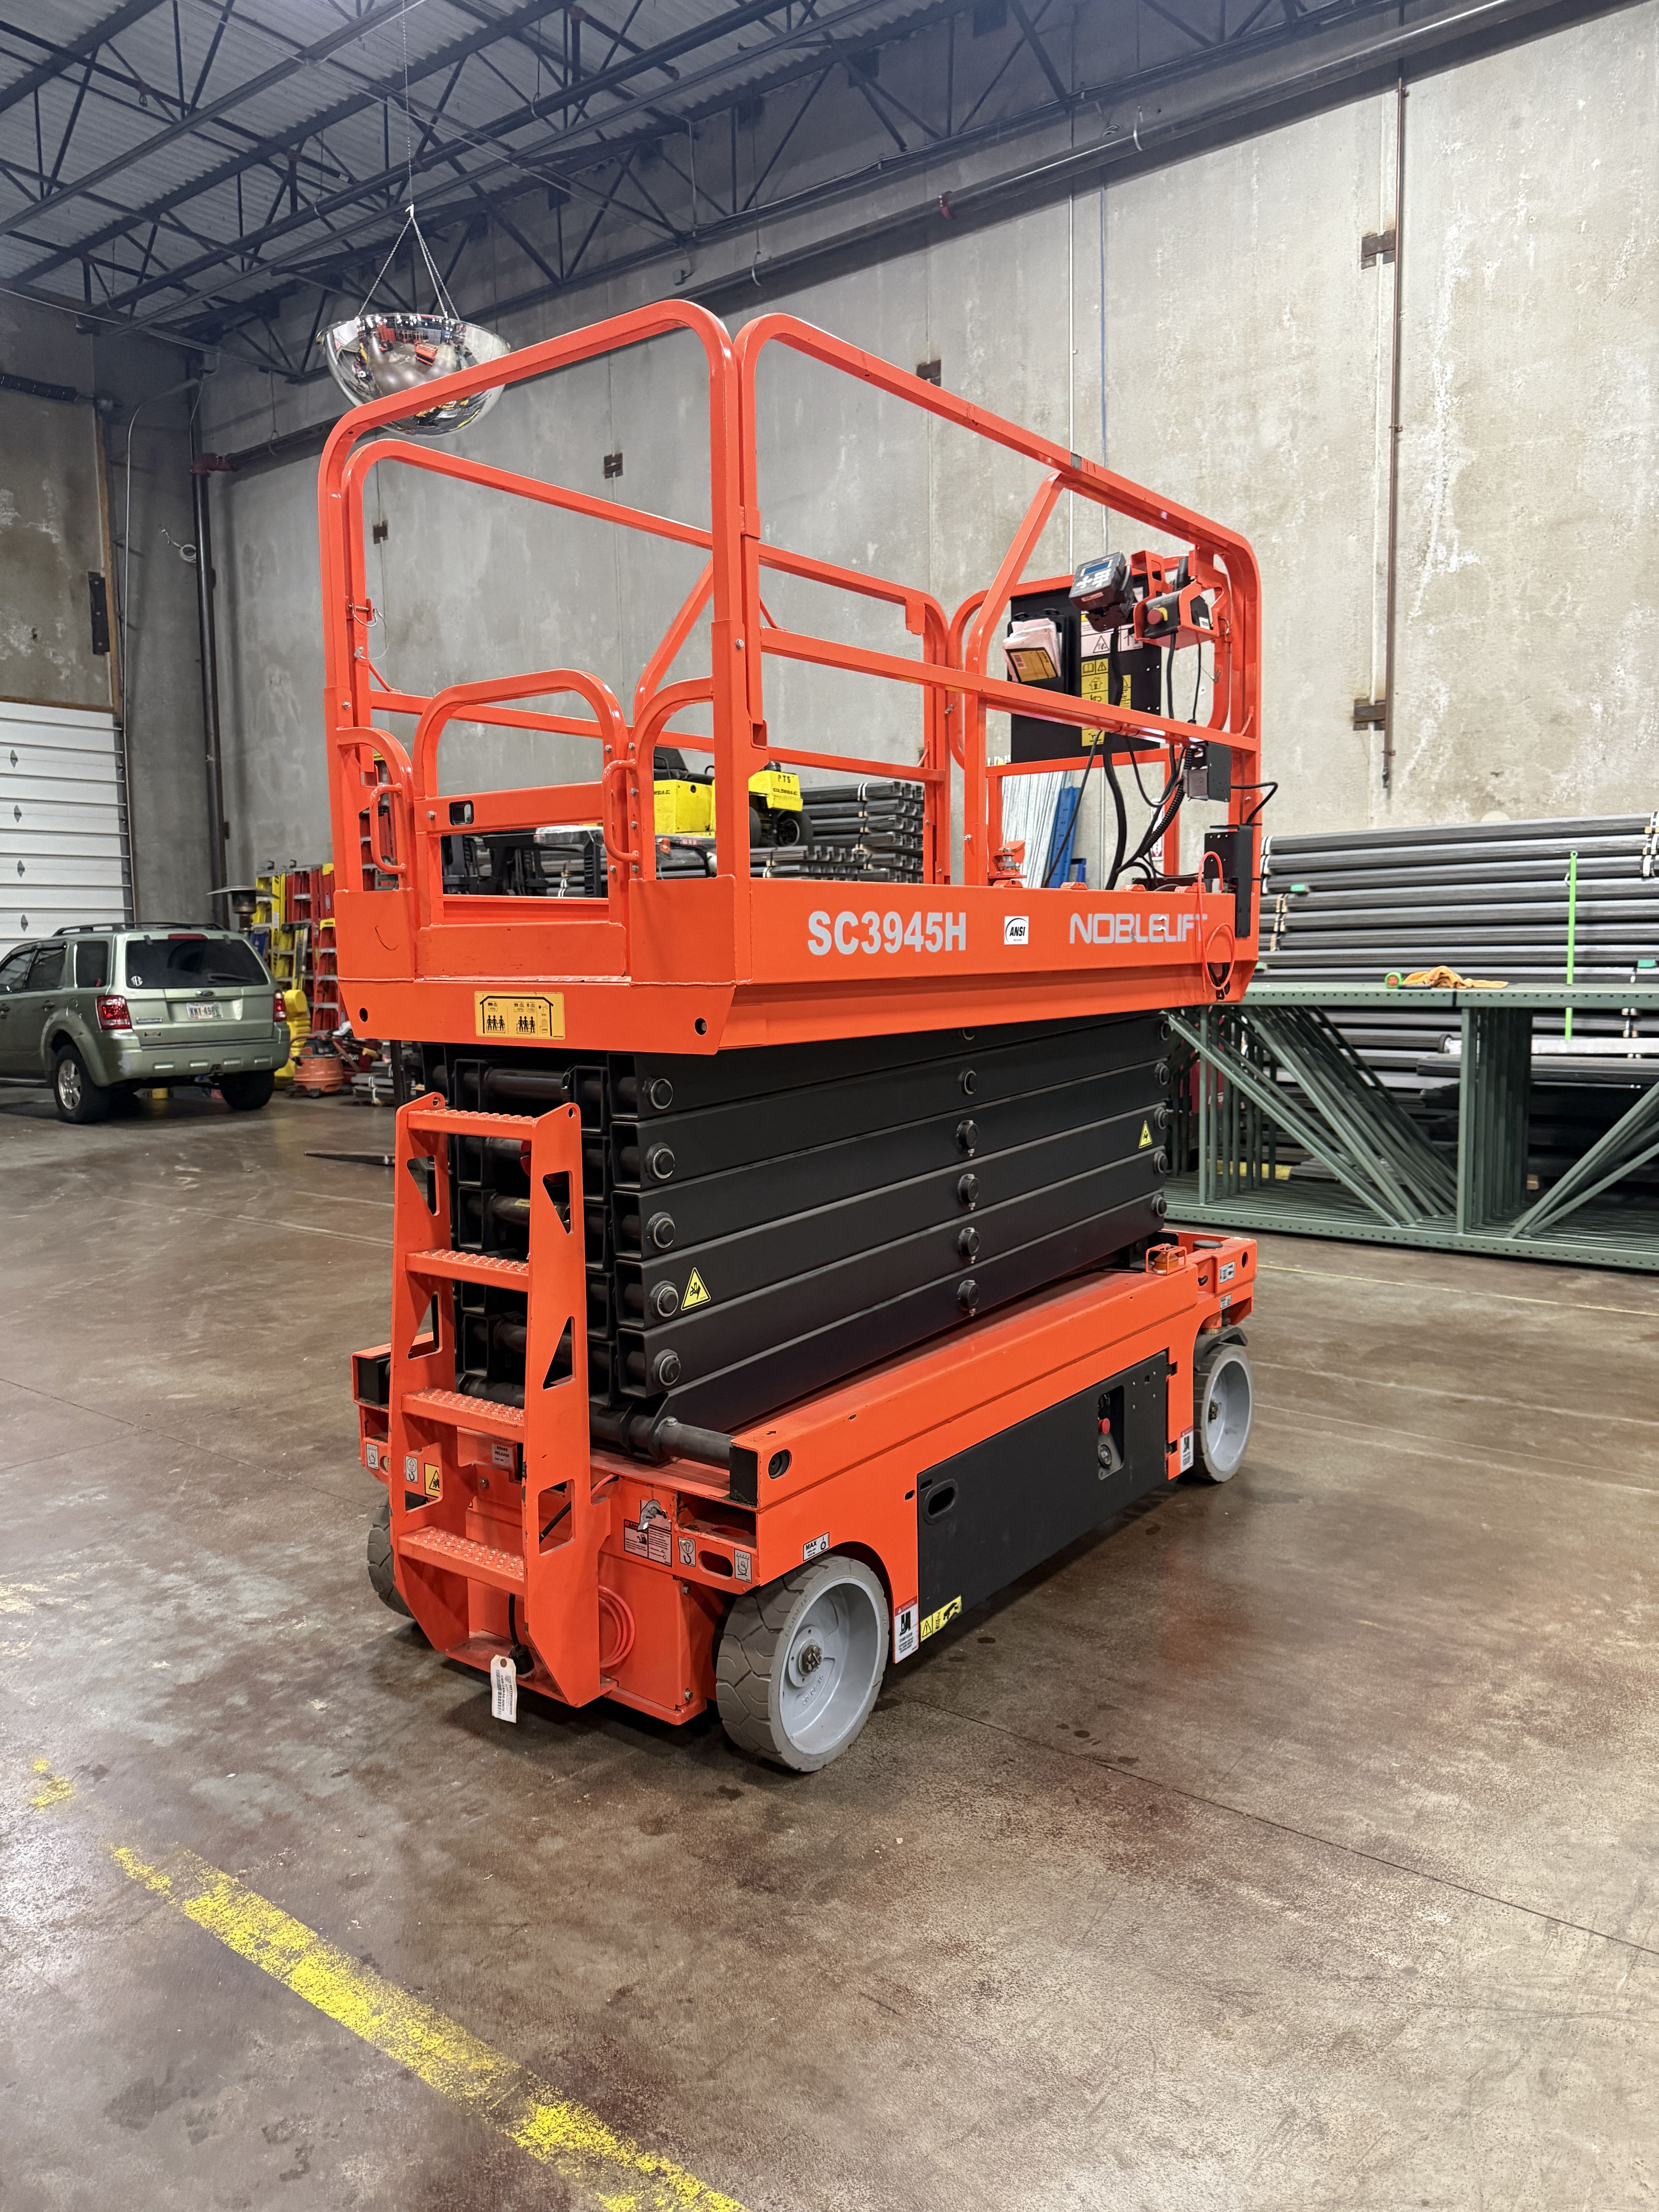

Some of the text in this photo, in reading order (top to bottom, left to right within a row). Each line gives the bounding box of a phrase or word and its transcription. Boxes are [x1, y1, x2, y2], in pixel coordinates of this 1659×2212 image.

[807, 911, 966, 956] SC3945H
[1009, 926, 1025, 936] ANSI
[1069, 913, 1208, 944] NOBLELIFT
[806, 1540, 817, 1551] MAX
